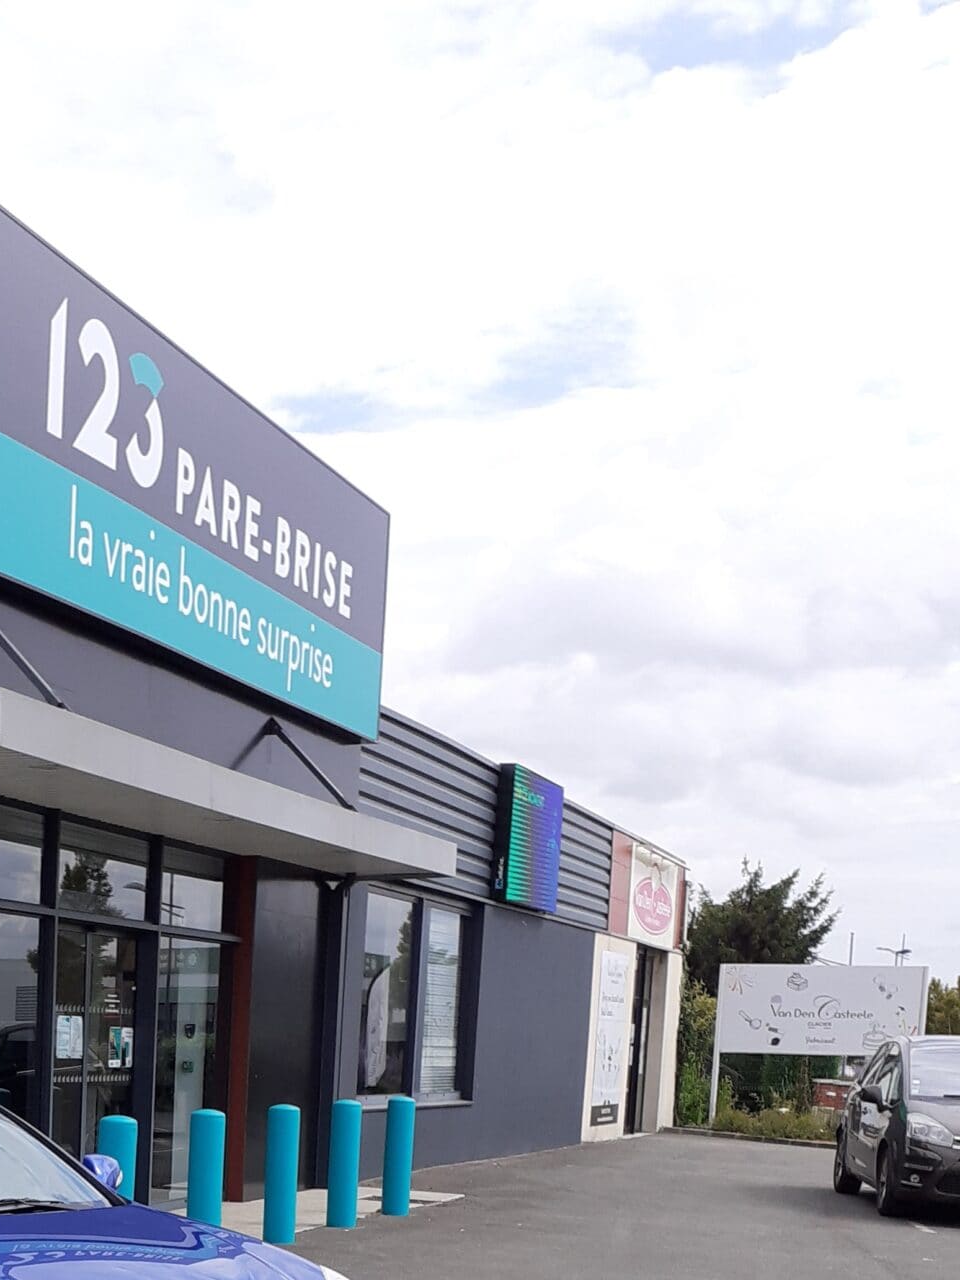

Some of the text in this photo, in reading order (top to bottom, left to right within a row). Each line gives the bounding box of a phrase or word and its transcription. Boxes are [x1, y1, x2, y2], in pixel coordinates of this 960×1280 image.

[47, 298, 353, 620] 123 PARE-BRISE
[69, 484, 333, 692] la vraie bonne surprise
[771, 1003, 792, 1018] Van
[794, 1008, 815, 1019] Den
